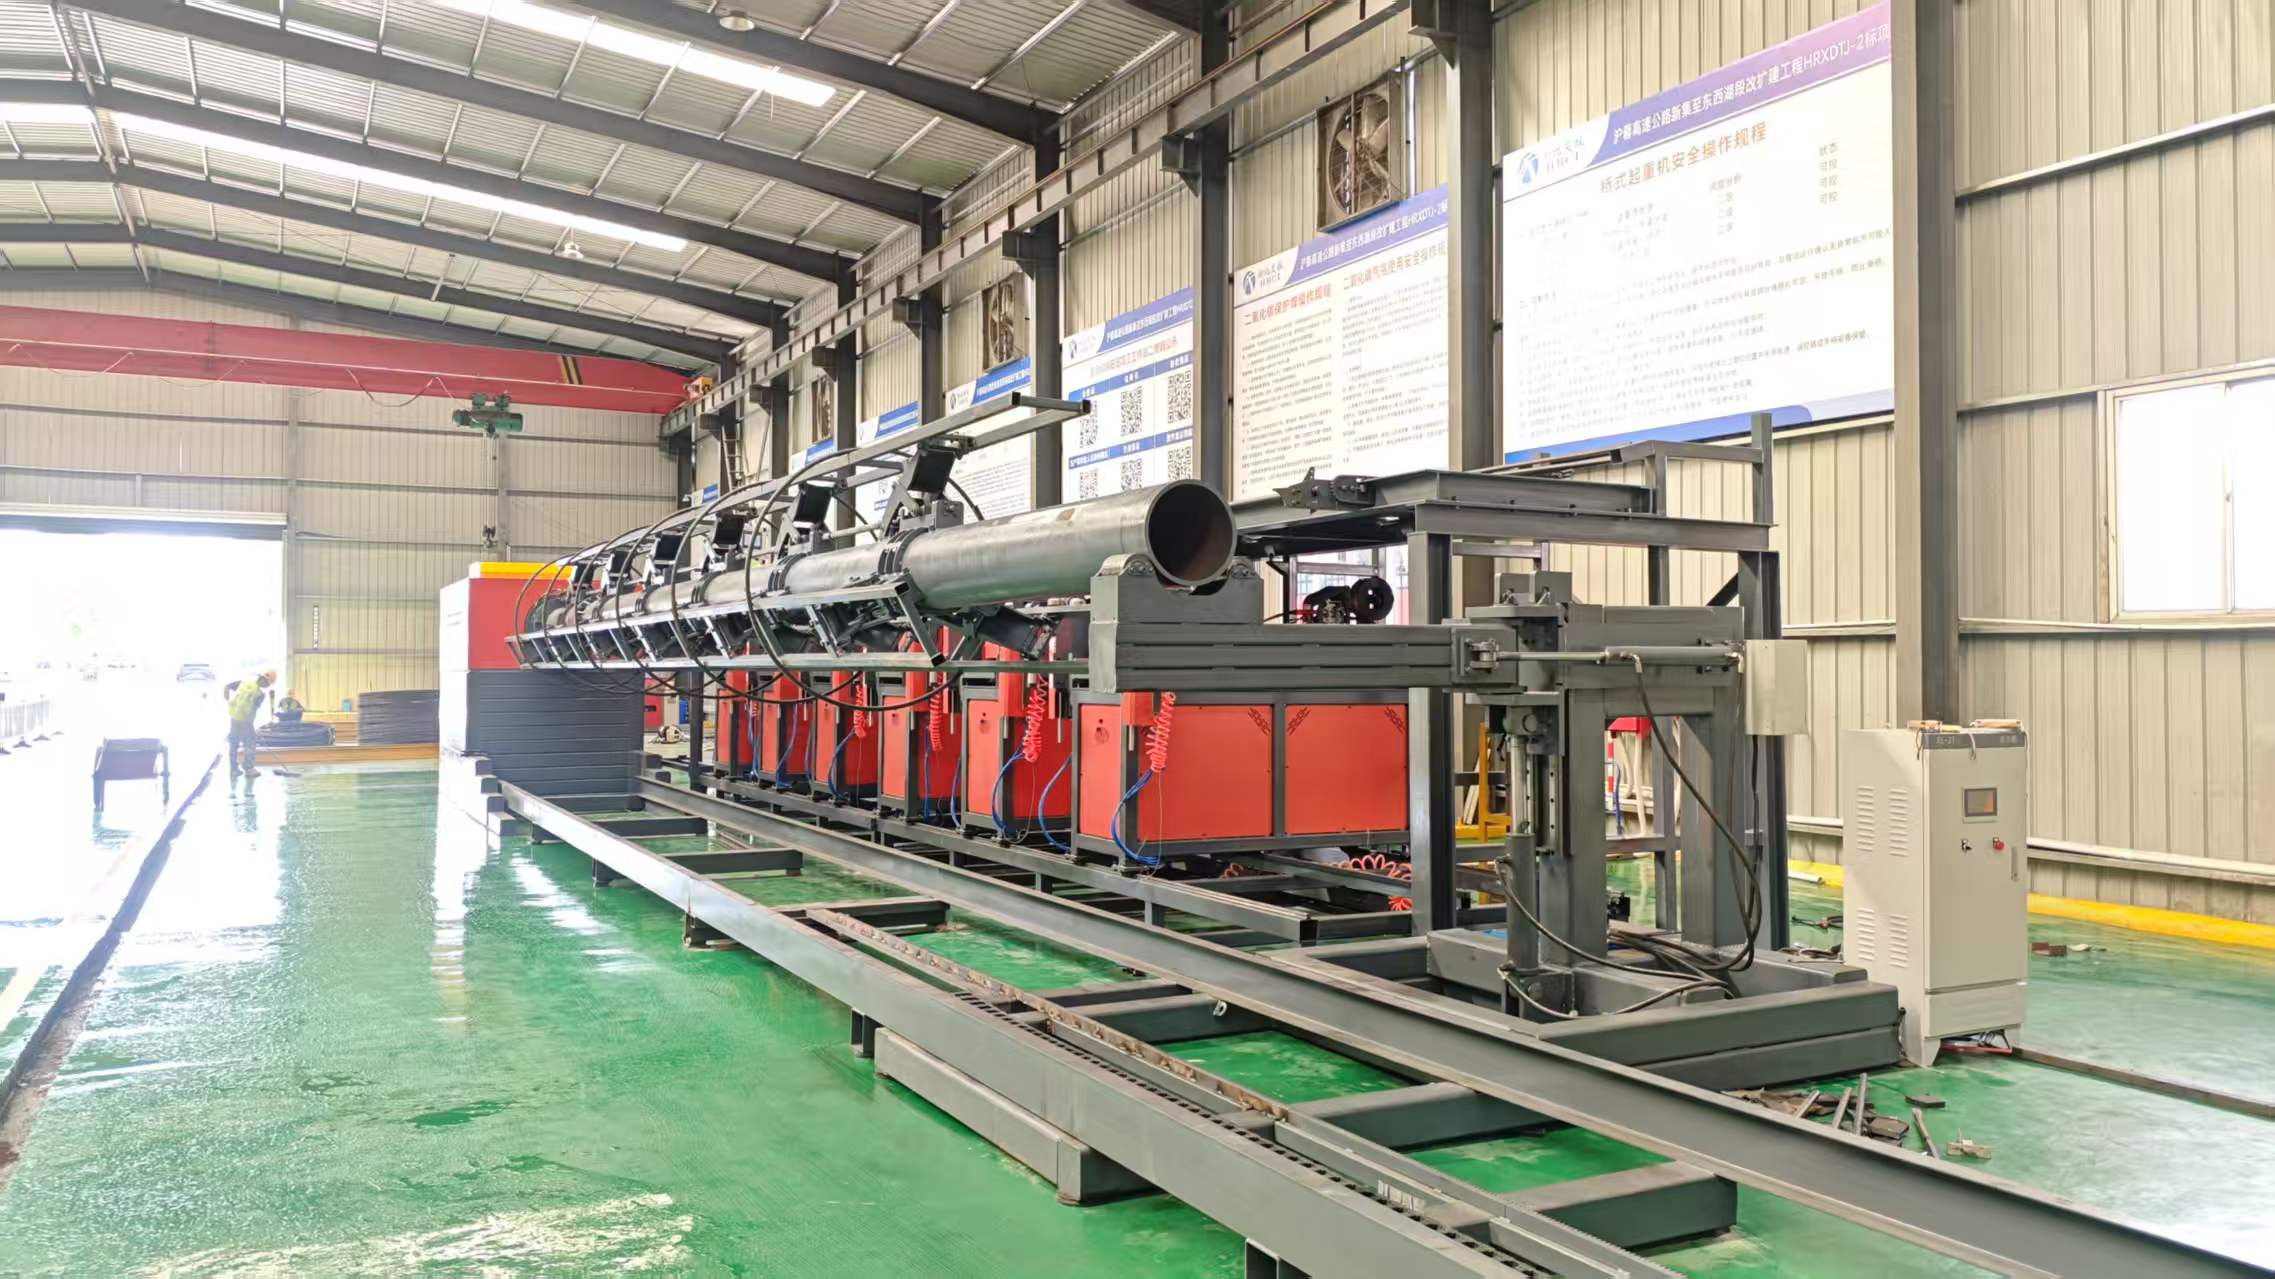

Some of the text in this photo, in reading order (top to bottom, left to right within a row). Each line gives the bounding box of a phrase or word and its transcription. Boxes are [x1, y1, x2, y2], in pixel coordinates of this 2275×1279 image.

[1600, 121, 1767, 193] 桥式起重机安全操作规程
